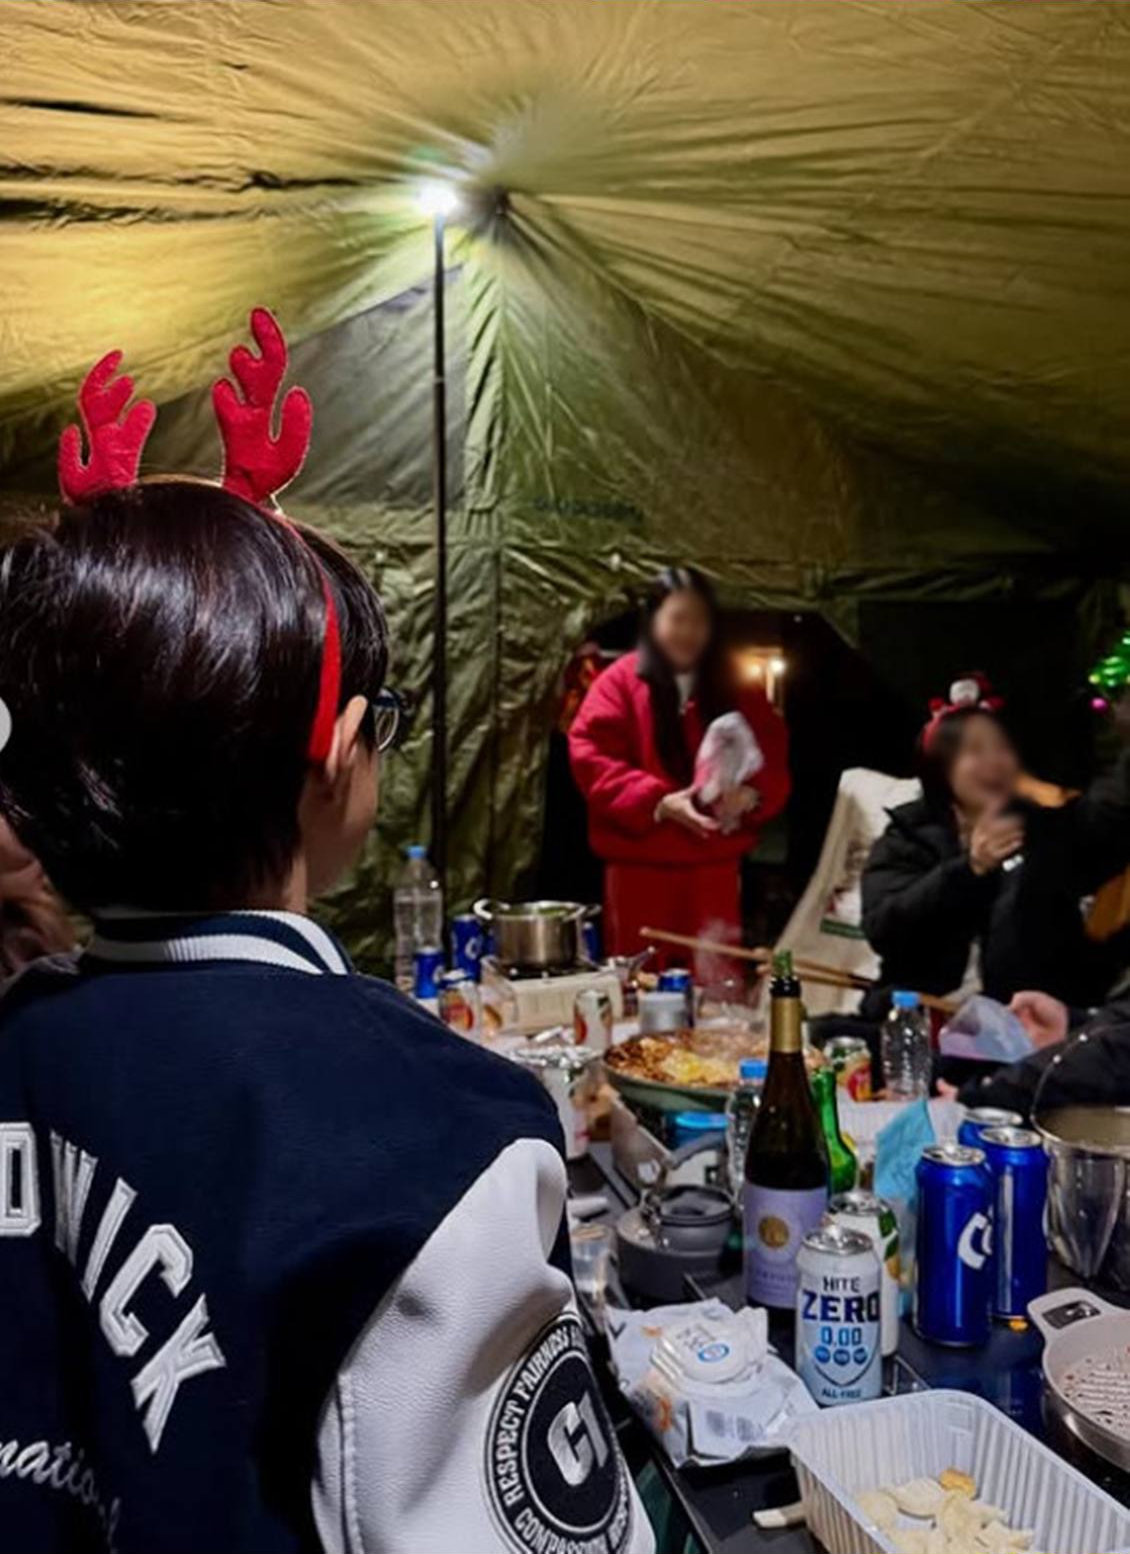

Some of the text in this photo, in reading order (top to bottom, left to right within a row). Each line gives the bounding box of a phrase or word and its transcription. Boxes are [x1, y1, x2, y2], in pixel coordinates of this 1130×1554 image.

[823, 1276, 861, 1292] HITE
[802, 1289, 880, 1323] ZERO
[821, 1326, 862, 1346] 0.00
[496, 1326, 569, 1507] RESPECT FAIRNESS
